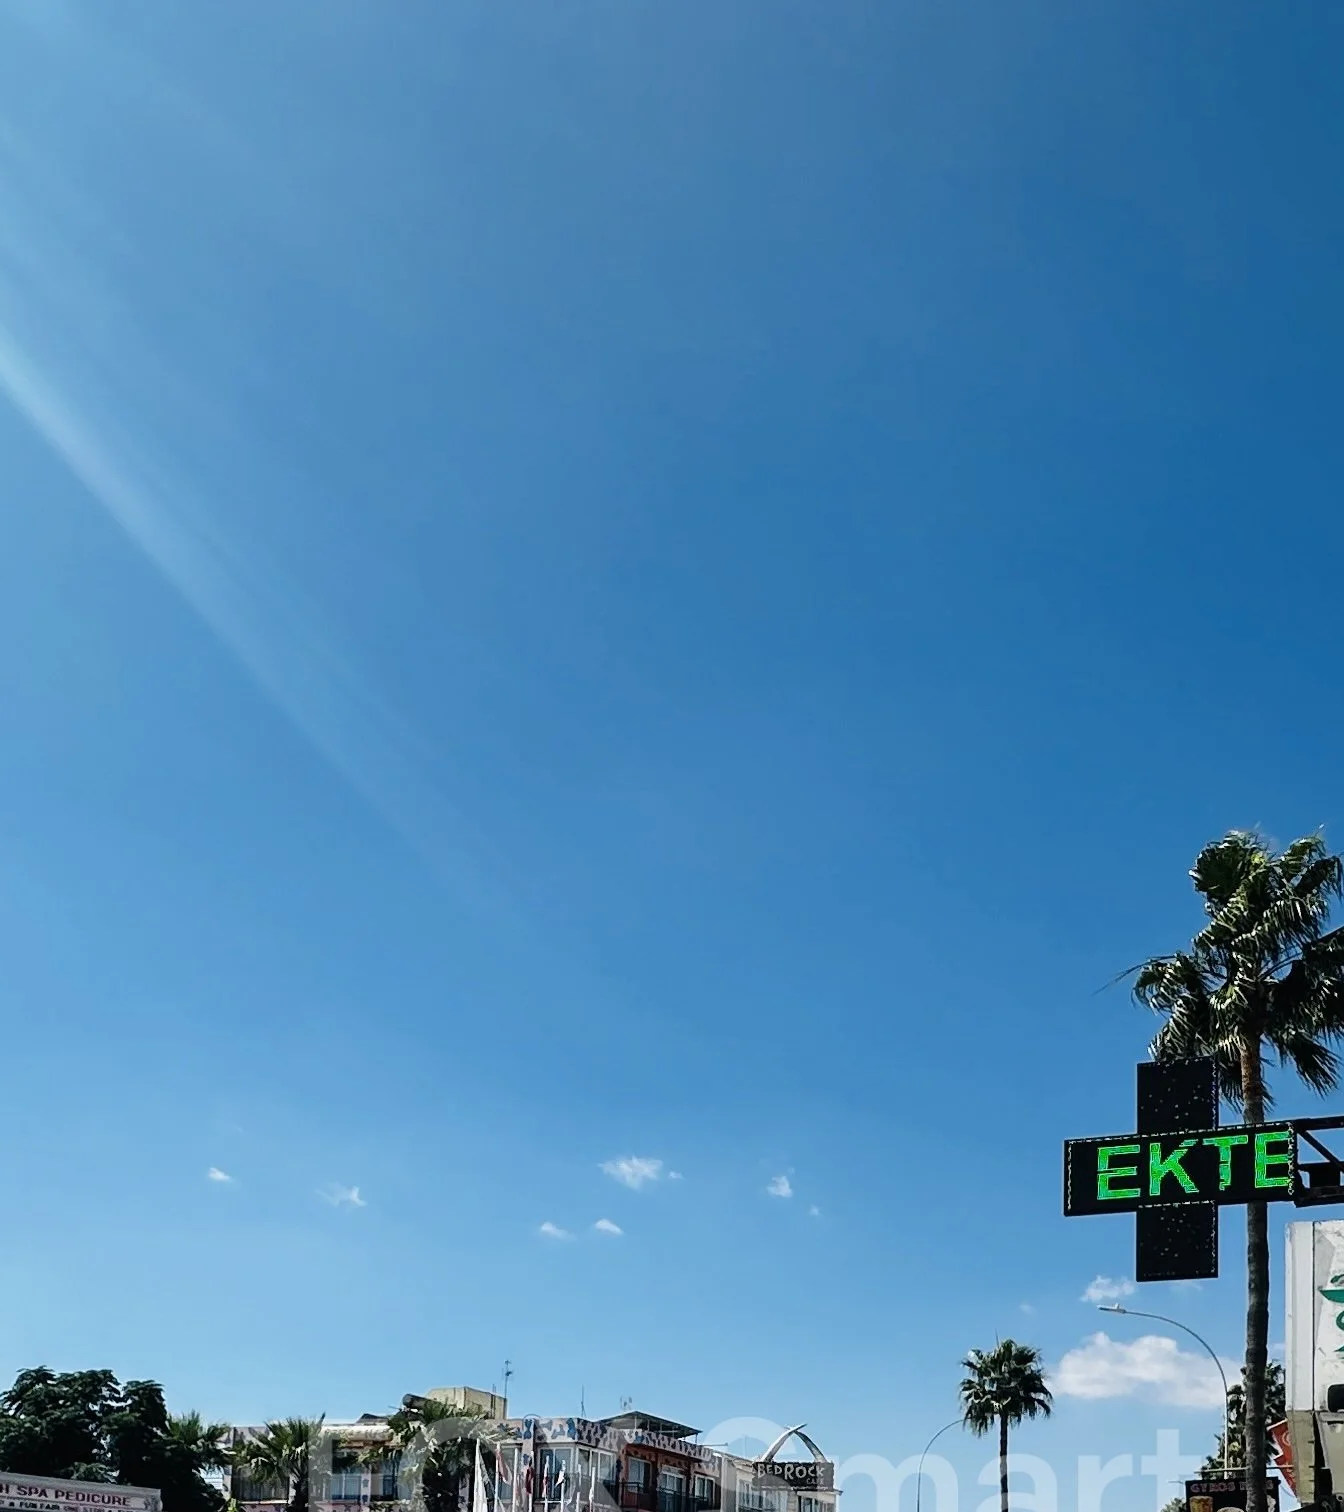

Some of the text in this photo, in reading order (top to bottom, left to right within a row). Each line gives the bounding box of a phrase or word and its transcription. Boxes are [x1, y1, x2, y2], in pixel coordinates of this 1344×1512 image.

[1190, 1482, 1235, 1494] GYROS
[16, 1485, 48, 1499] SPA
[55, 1489, 132, 1506] PEDICURE
[19, 1501, 37, 1509] FUN
[40, 1503, 60, 1511] FAIR
